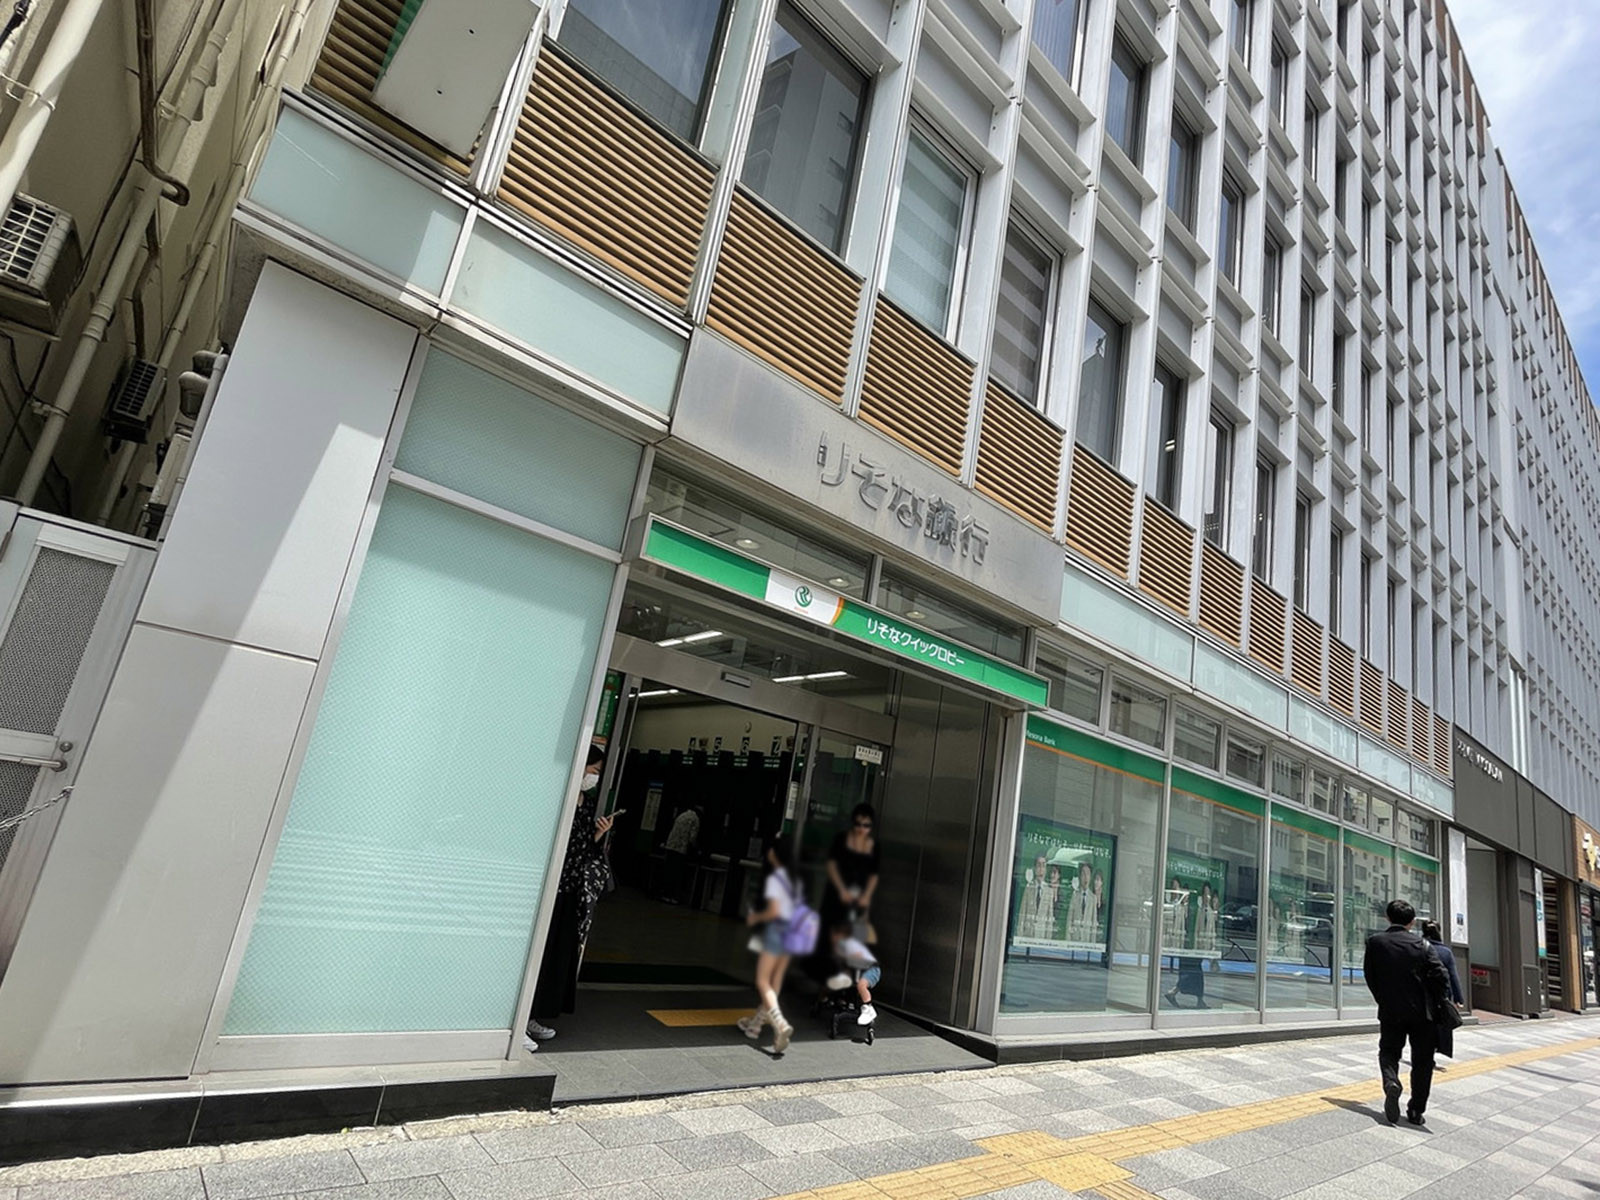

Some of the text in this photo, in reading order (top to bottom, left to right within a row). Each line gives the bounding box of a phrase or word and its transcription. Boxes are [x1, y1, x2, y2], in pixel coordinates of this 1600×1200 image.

[817, 431, 989, 566] りそな銀行
[867, 617, 965, 666] りそなクイックロビー
